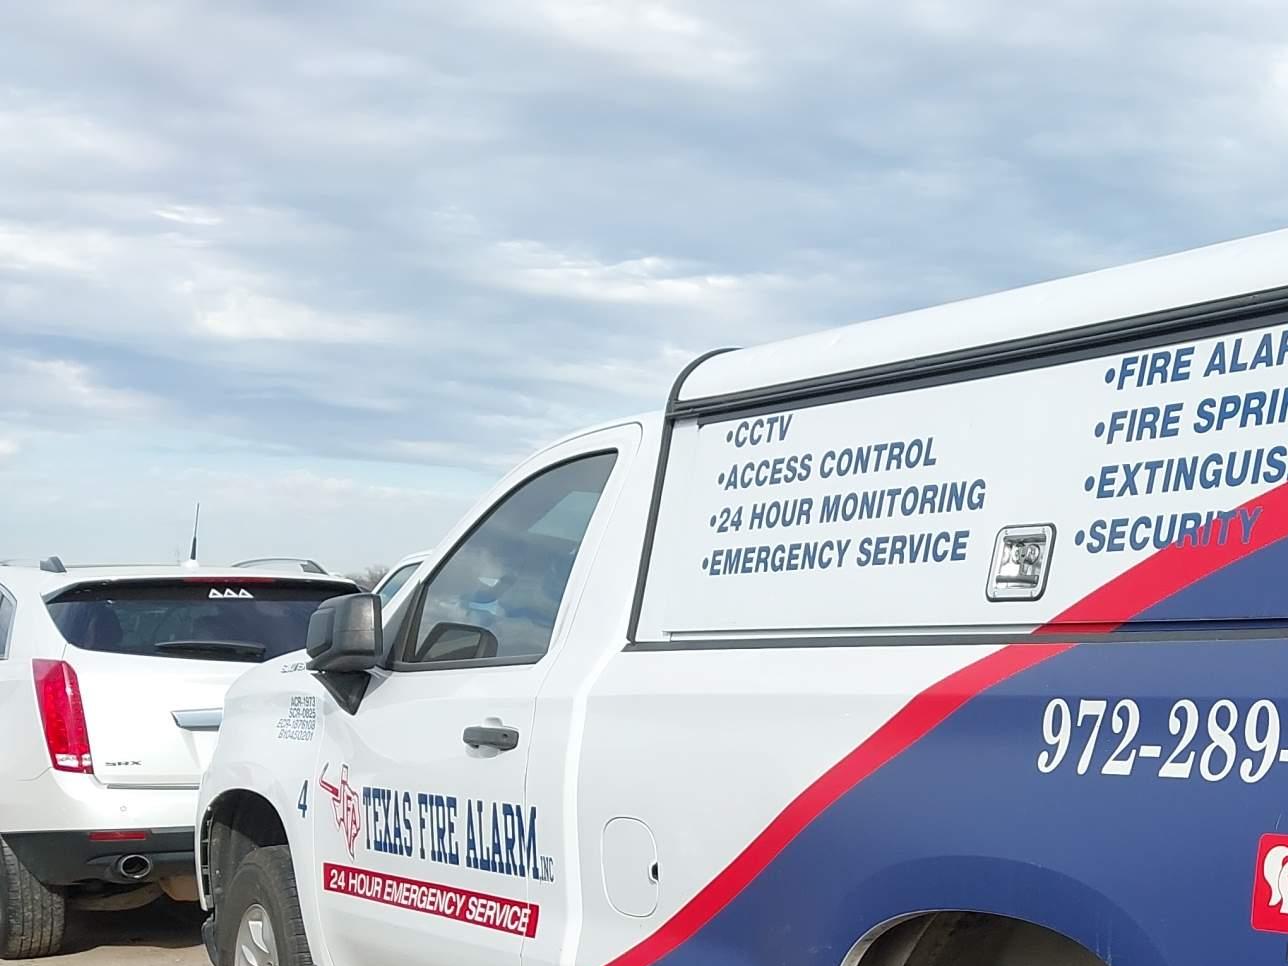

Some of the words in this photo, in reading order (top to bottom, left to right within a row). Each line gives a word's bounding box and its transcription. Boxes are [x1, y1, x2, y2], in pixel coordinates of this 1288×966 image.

[1117, 346, 1195, 391] FIRE
[735, 415, 792, 447] CCTV
[1107, 398, 1183, 444] FIRE
[725, 454, 812, 490] ACCESS
[820, 438, 936, 478] CONTROL
[719, 506, 742, 533] 24
[750, 497, 811, 528] HOUR
[820, 480, 985, 524] MONITORING
[1086, 507, 1264, 553] SECURITY
[709, 537, 846, 576] EMERGENCY
[854, 531, 969, 565] SERVICE
[298, 780, 308, 818] 4
[363, 787, 412, 857] TEXAS
[418, 792, 459, 865] FIRE
[330, 868, 345, 890] 24
[349, 872, 382, 898] HOUR
[384, 881, 463, 917] EMERGENCY
[465, 896, 531, 932] SERVICE
